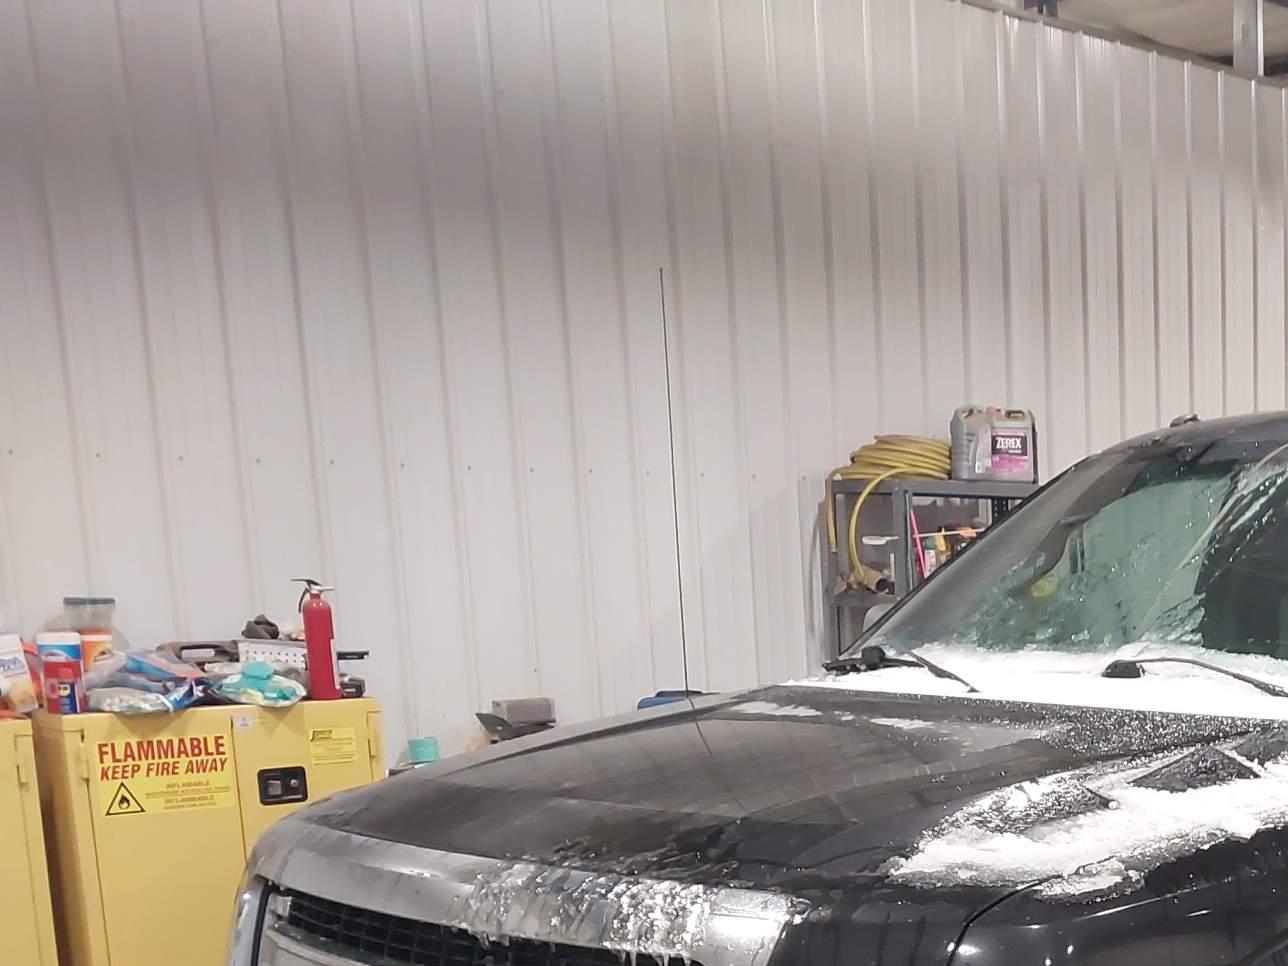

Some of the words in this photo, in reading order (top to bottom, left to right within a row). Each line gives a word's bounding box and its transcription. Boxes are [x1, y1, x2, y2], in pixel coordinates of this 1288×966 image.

[995, 437, 1022, 449] ZEREX
[97, 736, 226, 764] FLAMMABLE
[100, 764, 141, 781] KEEP
[146, 761, 180, 778] FIRE
[185, 757, 228, 774] AWAY
